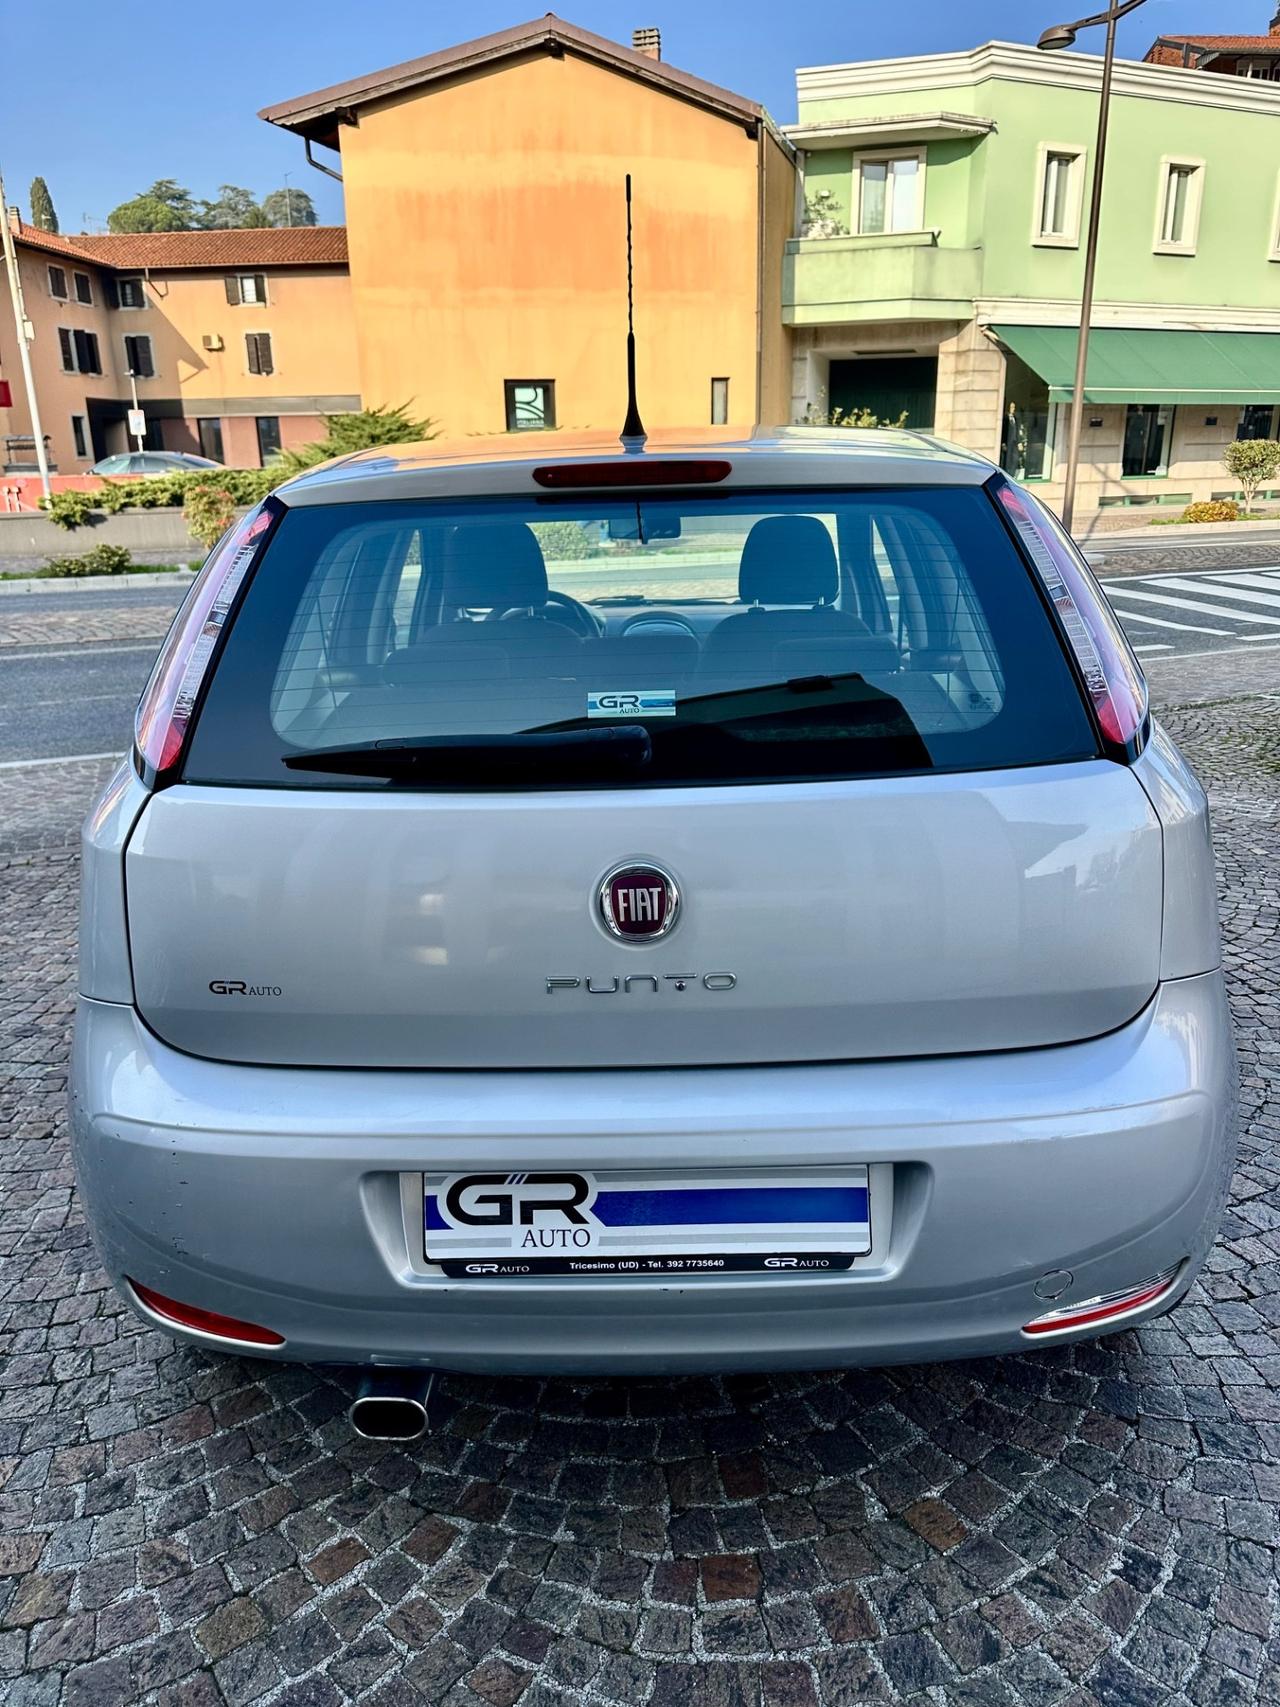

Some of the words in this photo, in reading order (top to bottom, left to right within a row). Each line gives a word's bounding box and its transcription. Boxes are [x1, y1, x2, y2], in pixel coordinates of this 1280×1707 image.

[599, 695, 640, 708] GR
[617, 887, 662, 922] FIAT
[208, 980, 247, 995] GR
[248, 986, 282, 996] AUTO
[546, 971, 738, 995] PUNTO
[446, 1173, 590, 1226] GR
[520, 1228, 591, 1248] AUTO
[465, 1263, 499, 1273] GR
[500, 1265, 530, 1273] AUTO
[569, 1262, 615, 1270] Tricesimo
[618, 1261, 639, 1270] (UD)
[667, 1260, 684, 1268] 392
[686, 1259, 725, 1267] 7735640
[764, 1257, 798, 1267] GR
